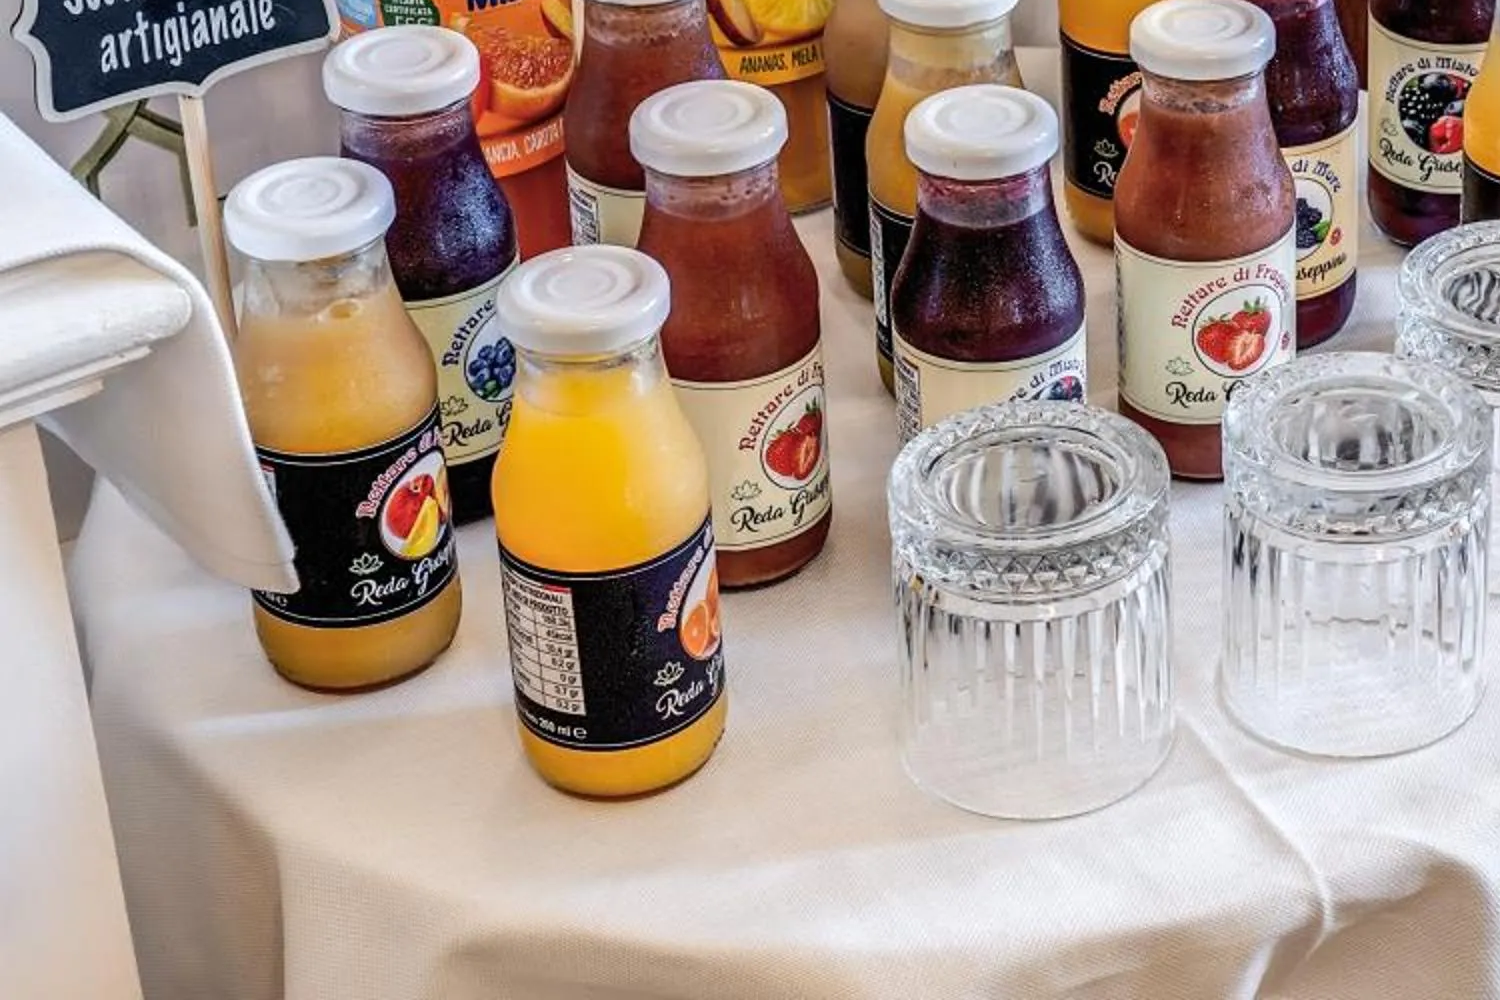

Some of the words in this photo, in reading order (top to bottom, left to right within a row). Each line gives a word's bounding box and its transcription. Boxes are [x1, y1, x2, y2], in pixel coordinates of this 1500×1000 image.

[1171, 275, 1228, 331] Nettare
[1233, 267, 1251, 283] di
[1029, 372, 1046, 390] di
[1165, 380, 1219, 409] Reda
[738, 383, 795, 452] Nettare
[442, 419, 495, 448] Reda
[729, 505, 786, 534] Reda
[351, 576, 410, 607] Reda
